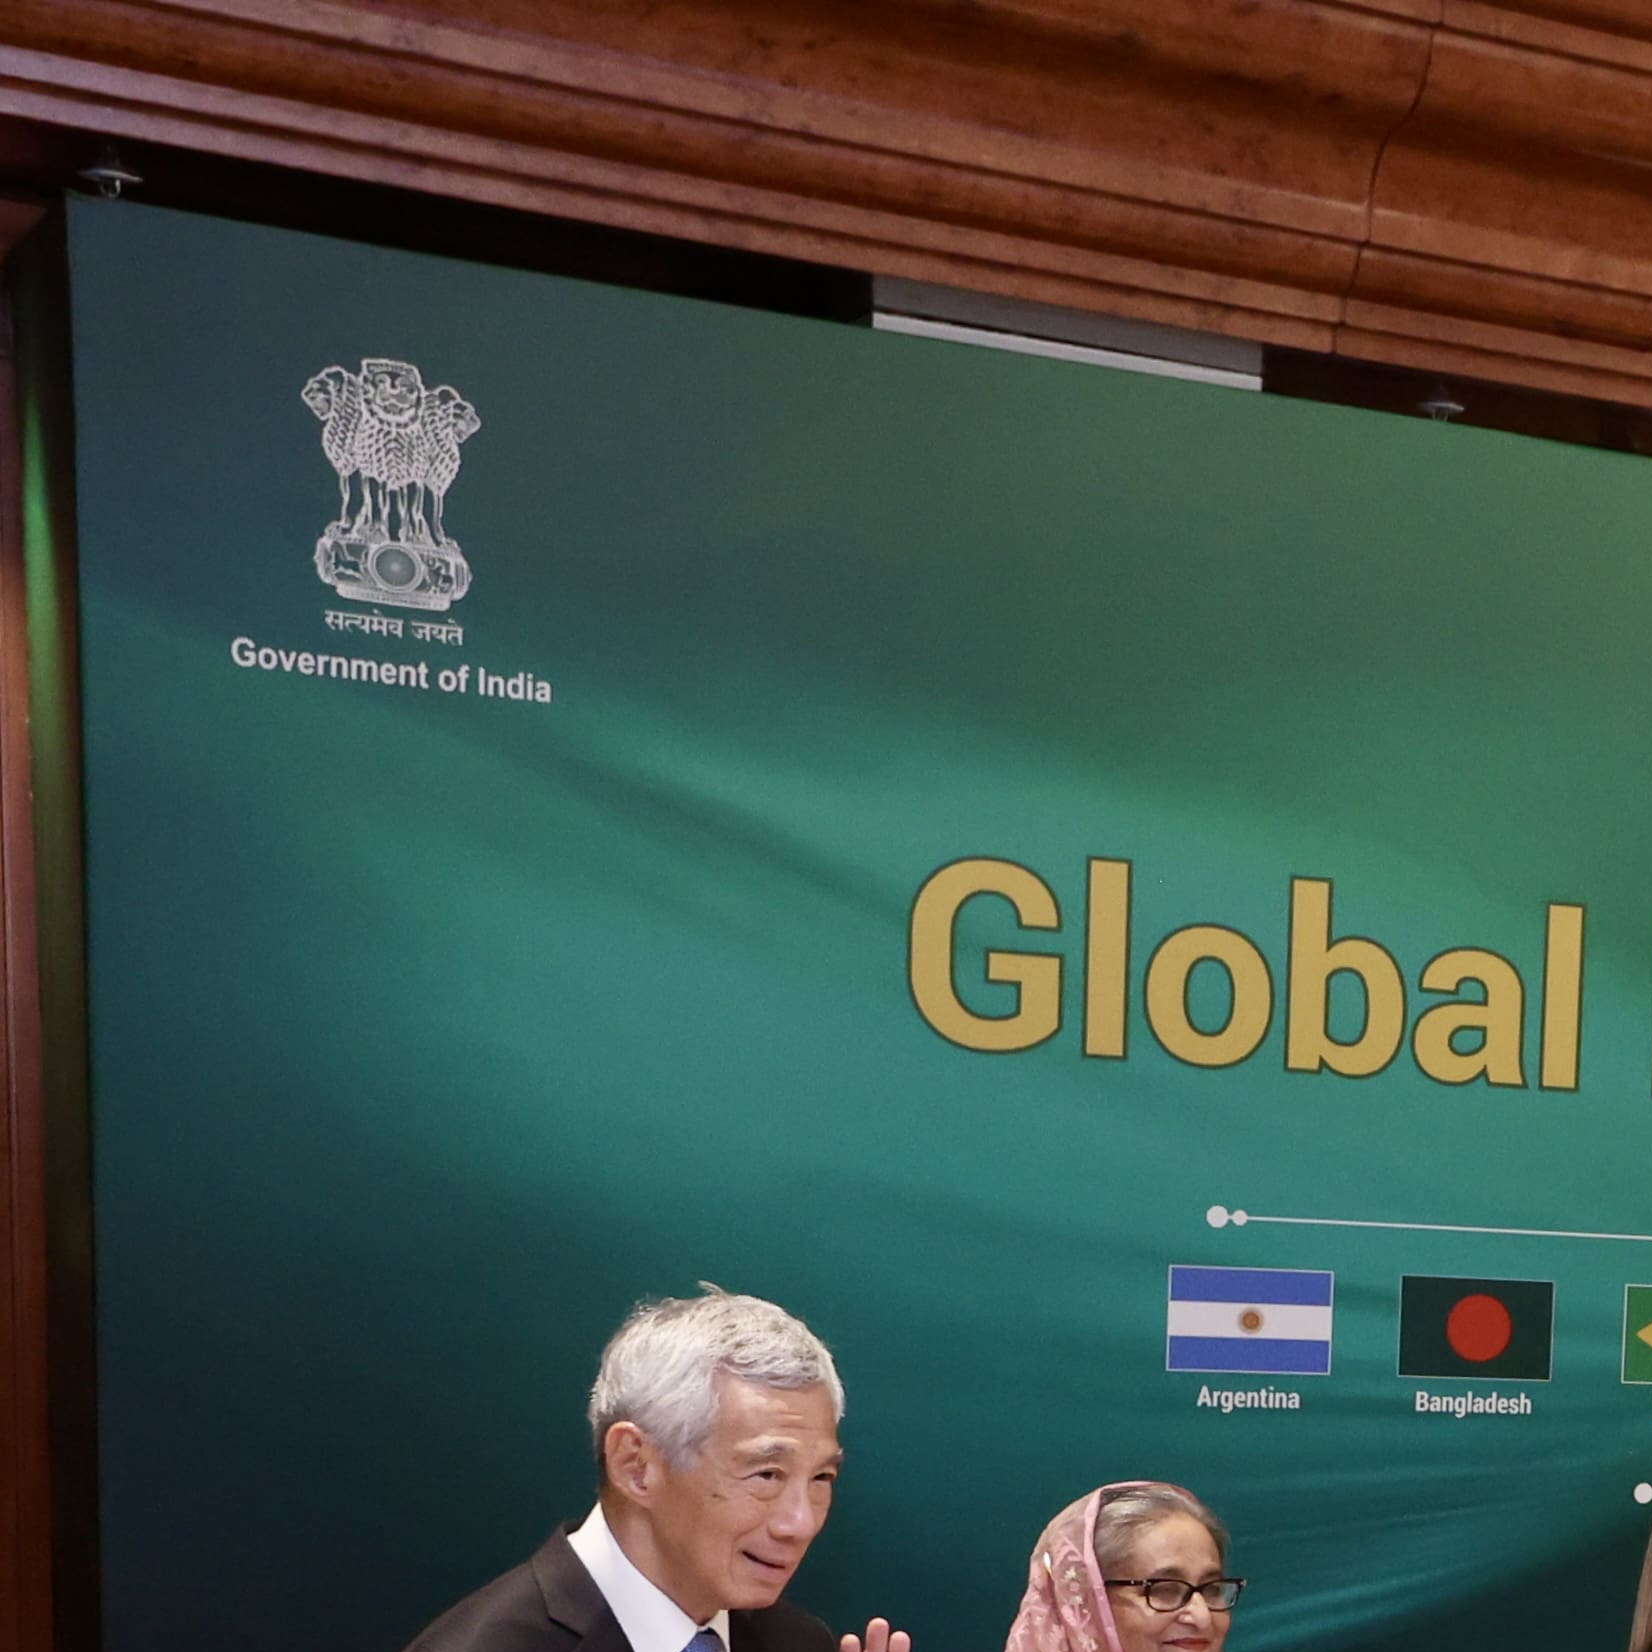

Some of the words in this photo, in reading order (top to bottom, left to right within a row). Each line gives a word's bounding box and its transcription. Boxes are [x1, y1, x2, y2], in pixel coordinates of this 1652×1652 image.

[325, 609, 403, 638] सत्यमेव
[412, 618, 463, 646] जयते
[231, 637, 429, 689] Government
[438, 664, 470, 692] of
[478, 667, 552, 703] India
[907, 855, 1587, 1093] Global
[1196, 1384, 1301, 1415] Argentina
[1414, 1391, 1532, 1420] Bangladesh
